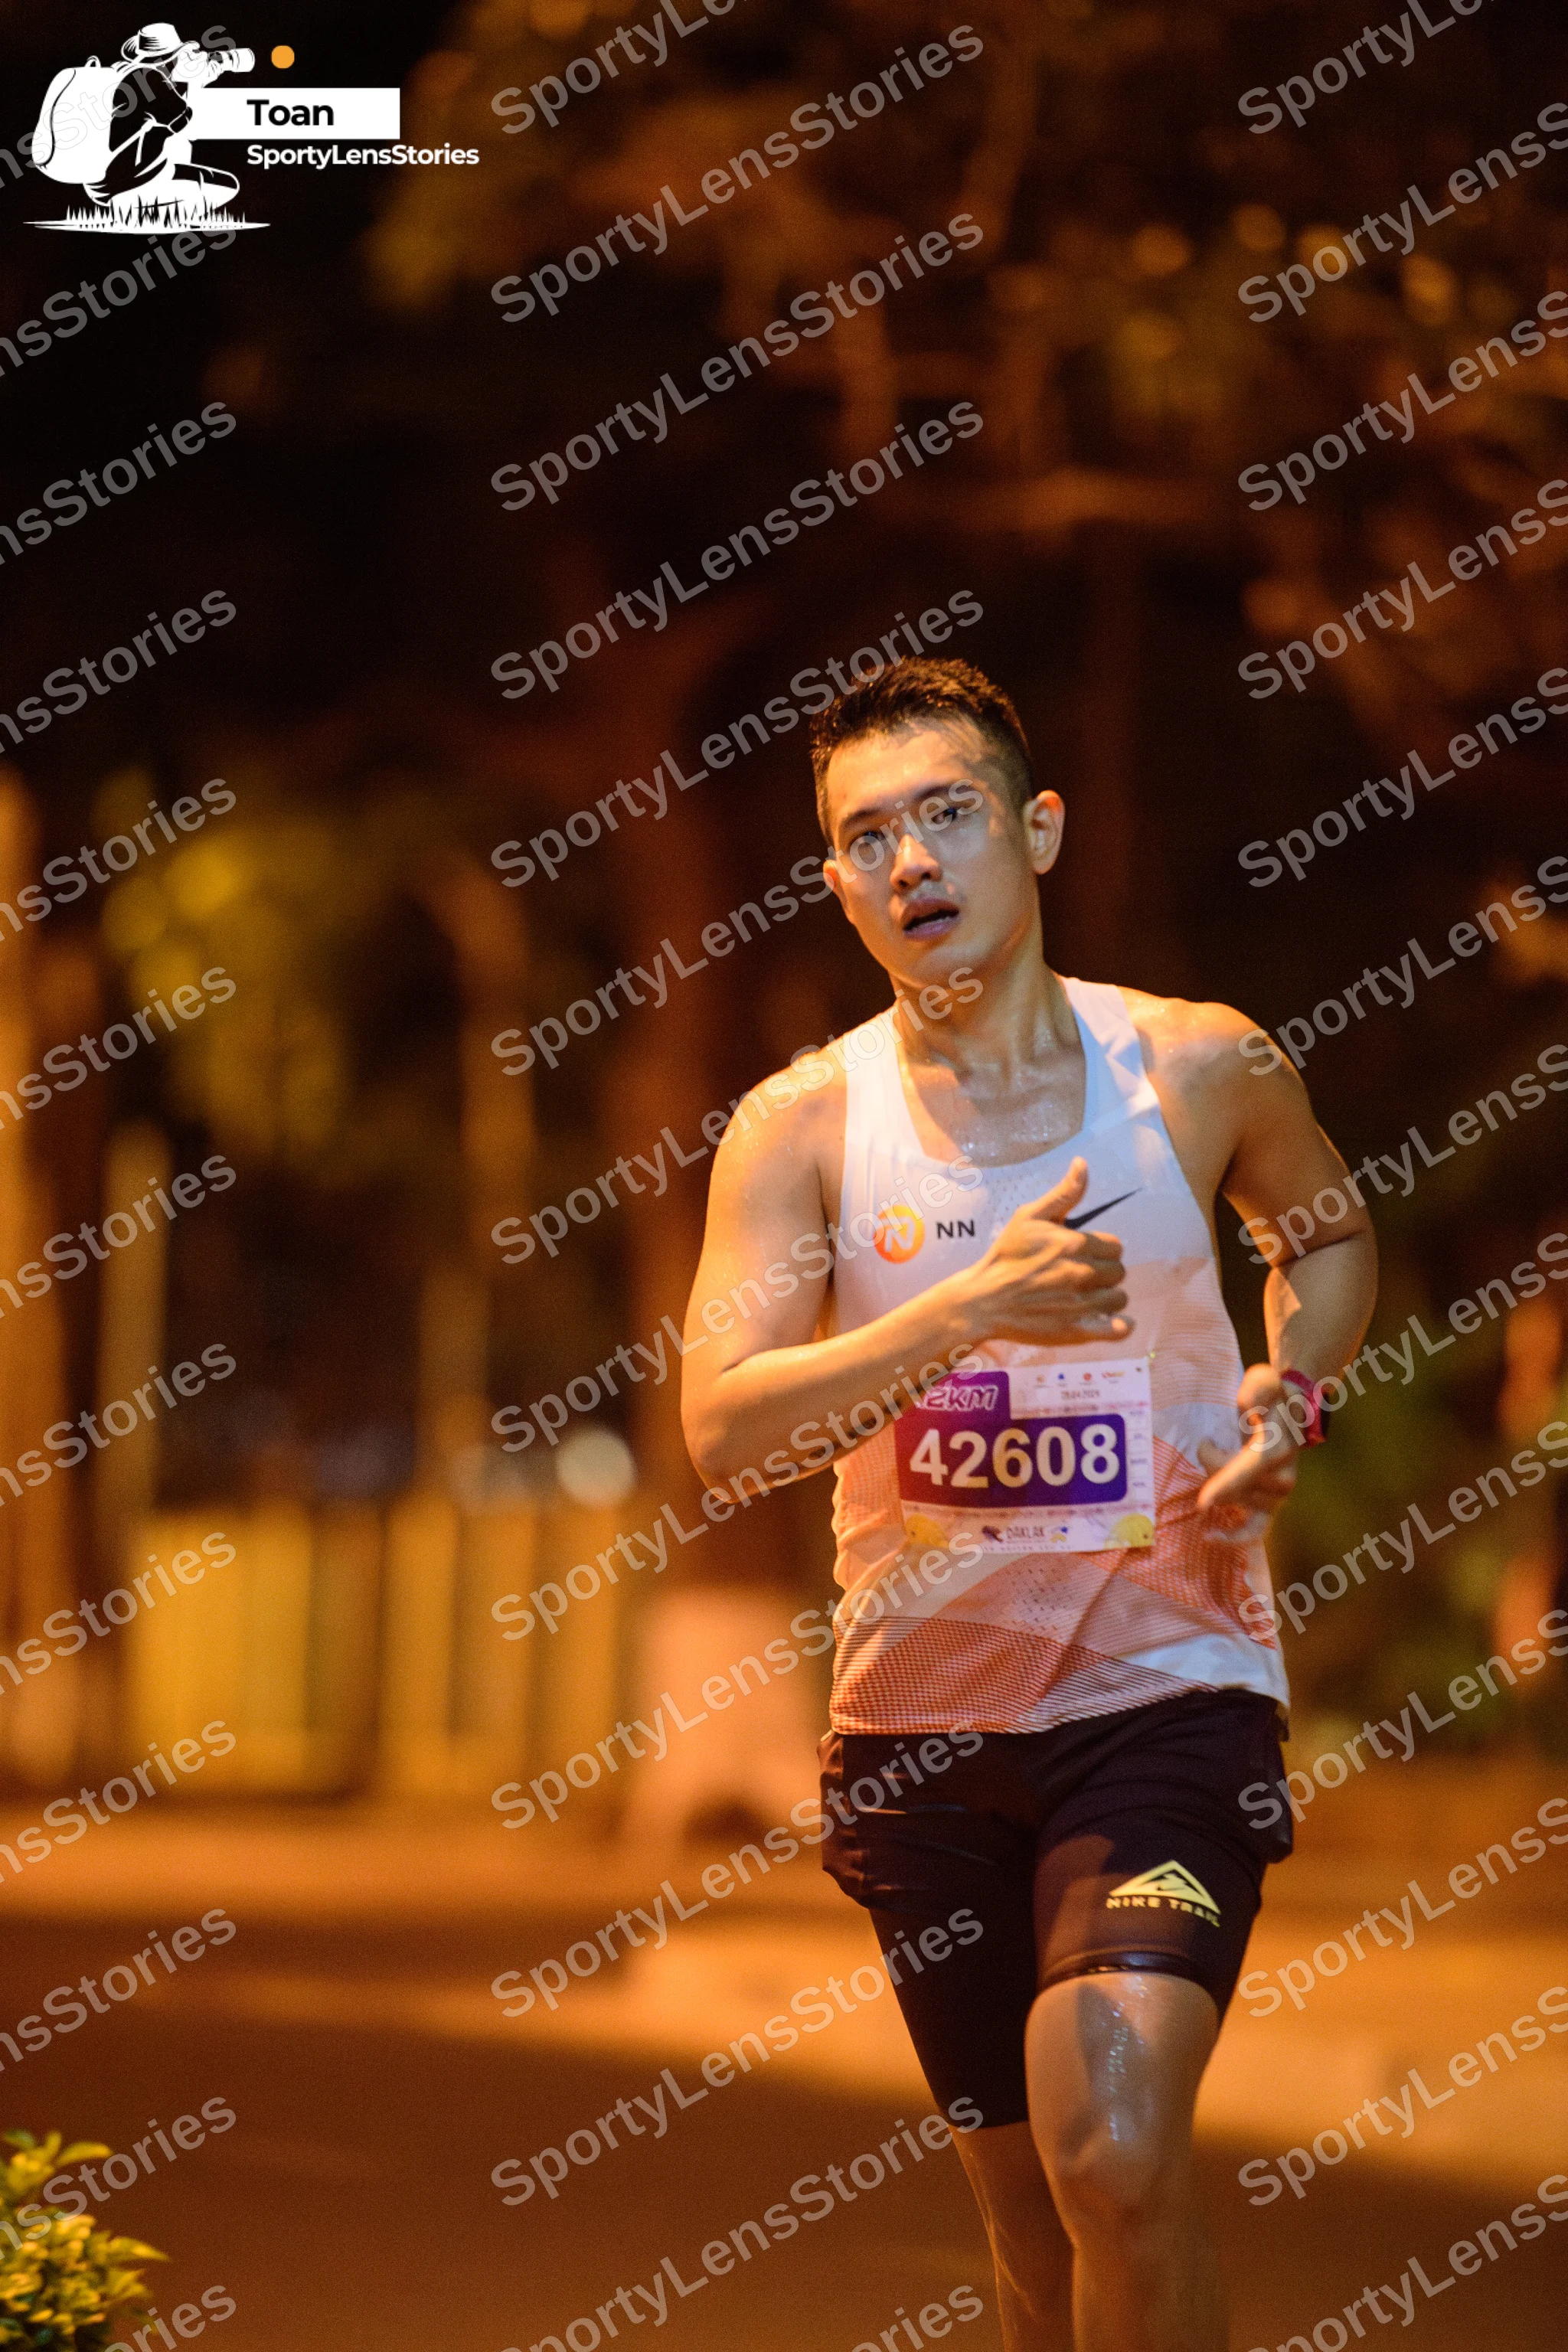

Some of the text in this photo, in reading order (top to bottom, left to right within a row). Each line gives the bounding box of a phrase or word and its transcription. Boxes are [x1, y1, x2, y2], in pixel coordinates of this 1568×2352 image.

[936, 1220, 975, 1239] NN
[910, 1424, 1119, 1488] 42608
[1106, 1896, 1161, 1909] NIKE
